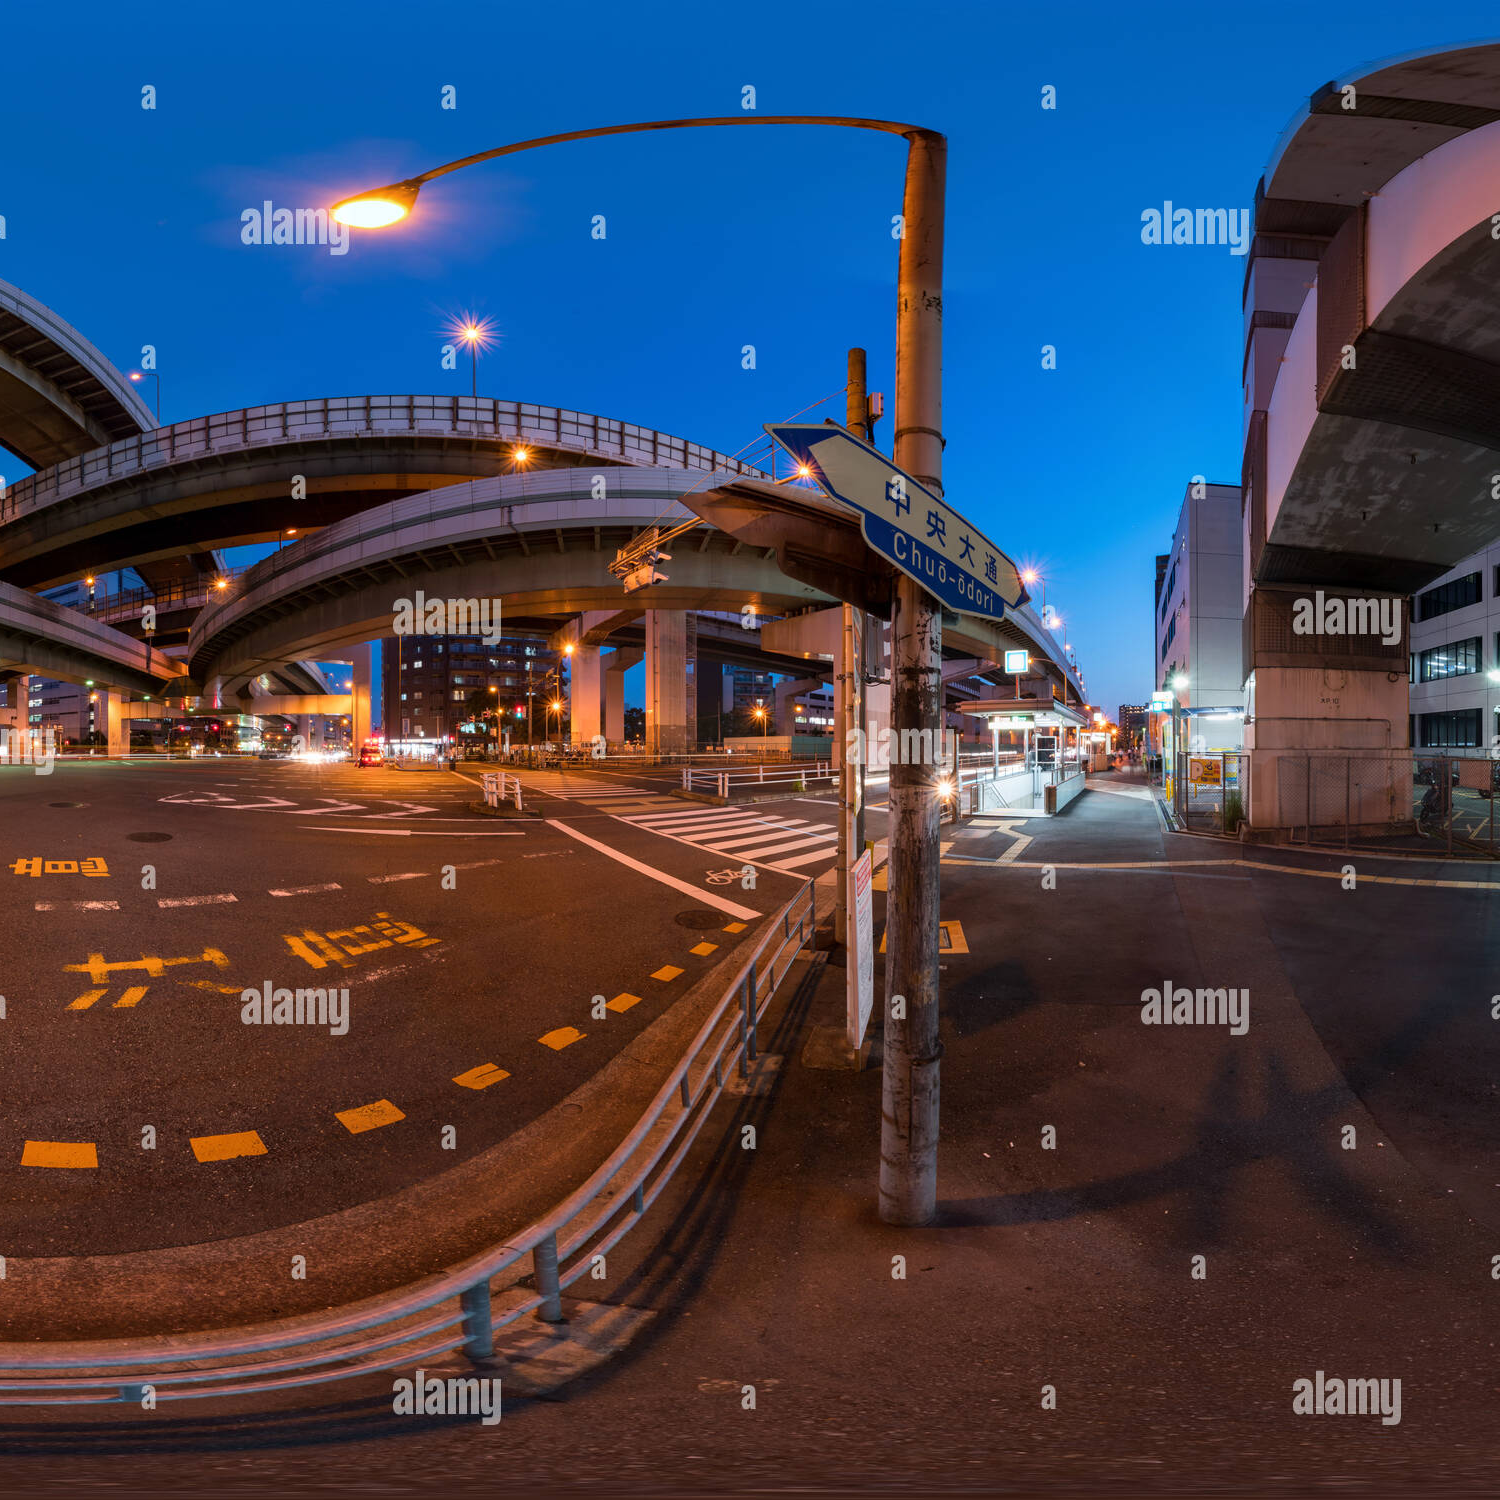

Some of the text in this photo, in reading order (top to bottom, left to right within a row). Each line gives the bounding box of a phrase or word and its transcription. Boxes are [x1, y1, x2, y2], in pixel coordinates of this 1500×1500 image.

[885, 479, 998, 586] 中央大通
[893, 532, 993, 613] Chuō-ōdori
